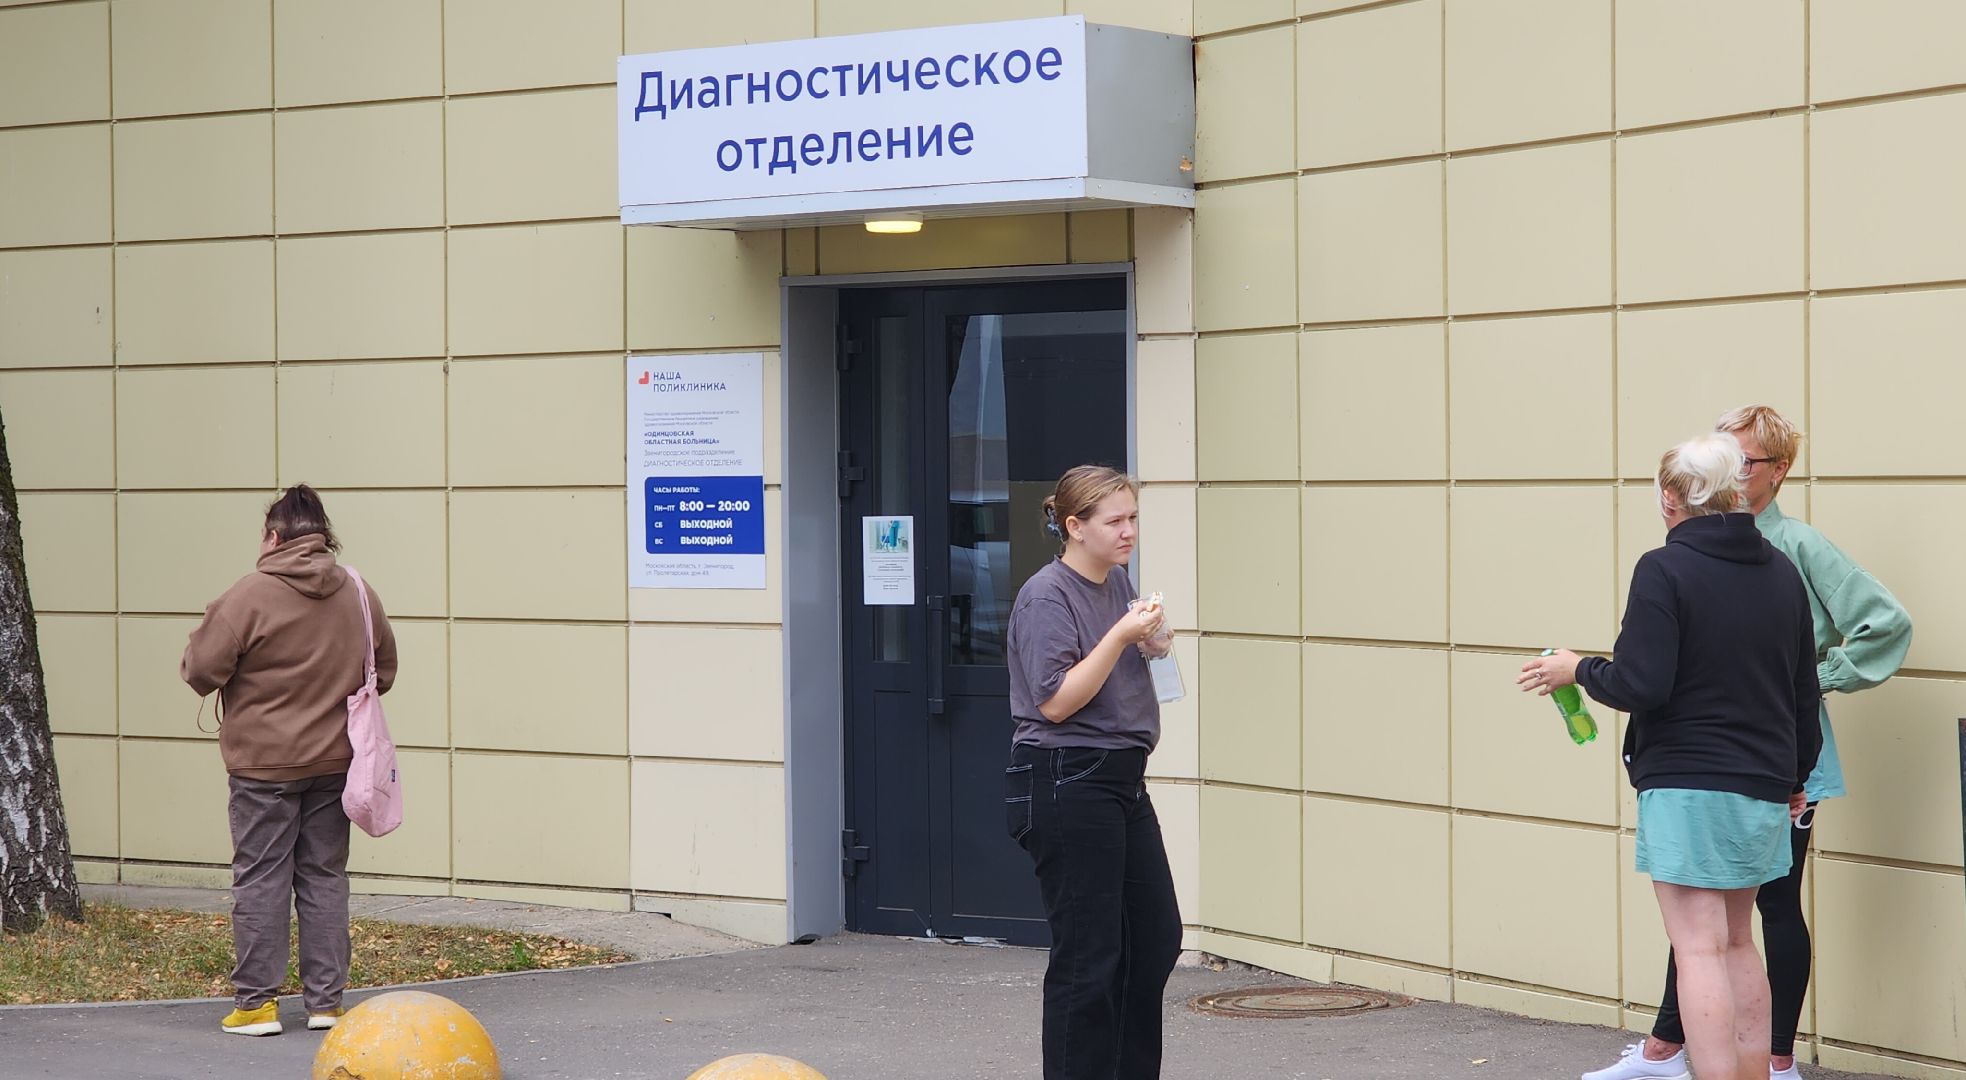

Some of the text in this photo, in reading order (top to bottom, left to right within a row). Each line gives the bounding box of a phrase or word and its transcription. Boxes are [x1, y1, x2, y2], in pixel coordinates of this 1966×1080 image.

[634, 46, 1064, 121] Диагностическое
[716, 121, 975, 175] отделение
[653, 371, 682, 381] НАША
[653, 382, 727, 393] ПОЛИКЛИНИКА
[643, 459, 742, 467] ДИАГНОСТИЧЕСКОЕ ОТДЕЛЕНИЕ
[679, 500, 704, 511] 8:00
[717, 500, 750, 511] 20:00
[680, 518, 733, 530] ВЫХОДНОЙ
[680, 534, 733, 546] ВЫХОДНОЙ
